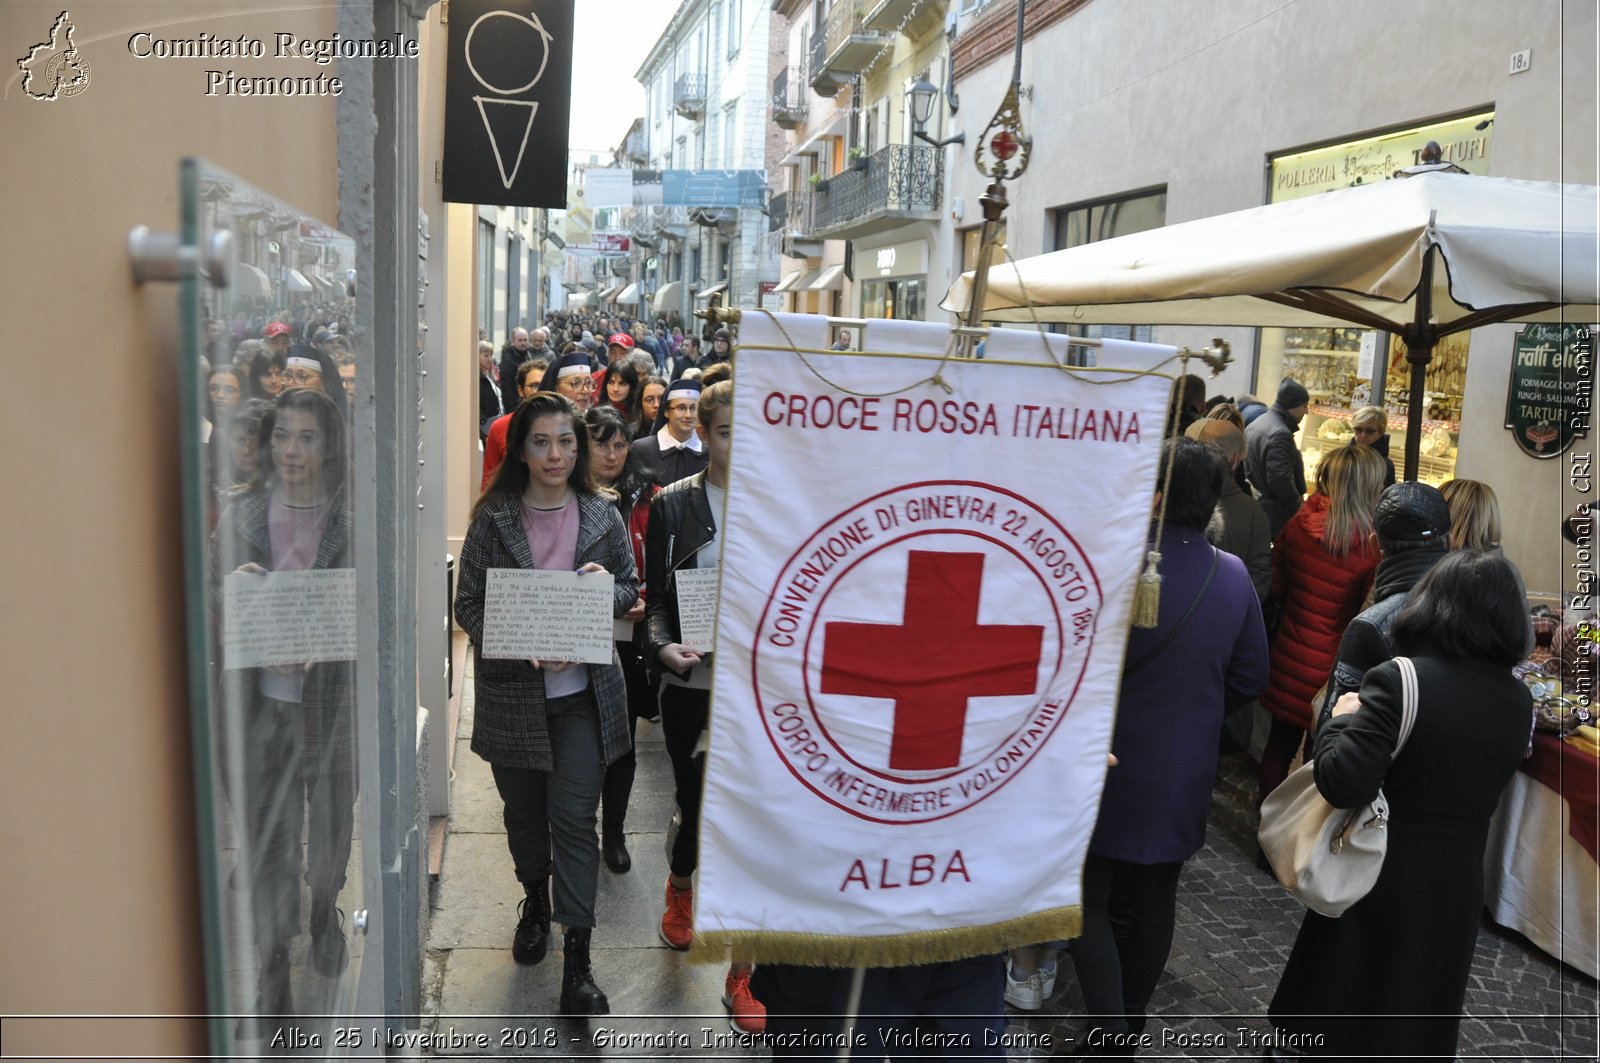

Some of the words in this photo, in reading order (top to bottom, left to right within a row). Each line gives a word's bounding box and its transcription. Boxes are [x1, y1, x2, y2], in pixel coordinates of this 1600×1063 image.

[1277, 164, 1336, 191] POLLERIA
[1517, 342, 1556, 367] ratti
[1517, 391, 1542, 401] FUNGHI
[1546, 393, 1577, 404] SALUMI
[1520, 378, 1556, 389] FORMAGGI
[1558, 381, 1576, 391] DOP
[763, 391, 880, 432] CROCE
[893, 398, 998, 436] ROSSA
[1013, 404, 1142, 444] ITALIANA
[1520, 405, 1567, 422] TARTUFI
[770, 518, 875, 647] CONVENZIONE
[875, 504, 900, 532] DI
[906, 495, 997, 526] GINEVRA
[1002, 508, 1028, 537] 22
[1024, 528, 1088, 603] AGOSTO
[772, 702, 829, 773] CORPO
[823, 769, 952, 814] INFERMIERE
[959, 698, 1064, 800] VOLONTARIE
[838, 849, 972, 892] ALBA
